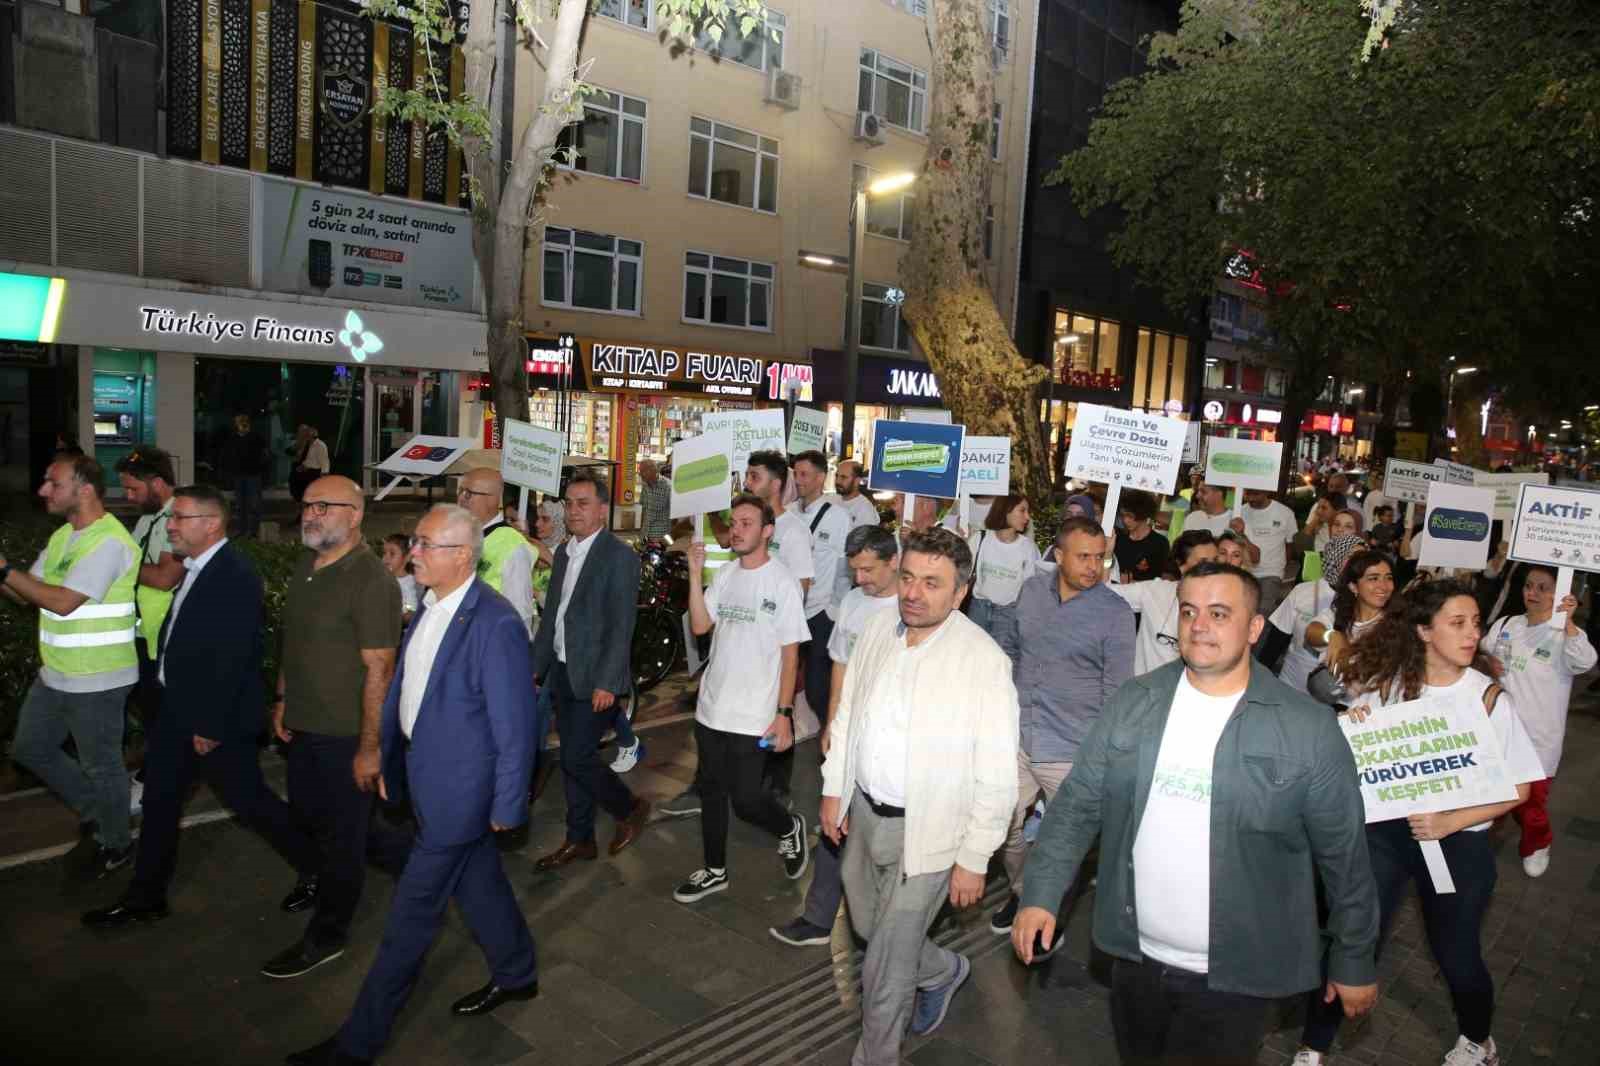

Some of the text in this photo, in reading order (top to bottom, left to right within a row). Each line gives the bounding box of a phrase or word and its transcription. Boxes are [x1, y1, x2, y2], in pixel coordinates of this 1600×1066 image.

[308, 216, 420, 244] döviz alın, satın!
[311, 200, 456, 235] 5 gün 24 saat anında
[141, 306, 336, 345] Türkiye Finans
[592, 343, 762, 384] KİTAP FUARI
[766, 361, 780, 400] 1
[1104, 410, 1159, 431] İnsan Ve
[1089, 425, 1127, 439] Çevre
[1130, 432, 1169, 448] Dostu
[1391, 467, 1419, 478] AKTİF
[1528, 501, 1592, 520] AKTİF
[1350, 716, 1449, 750] ŞEHRİNİN
[1376, 775, 1463, 801] KEŞFET!
